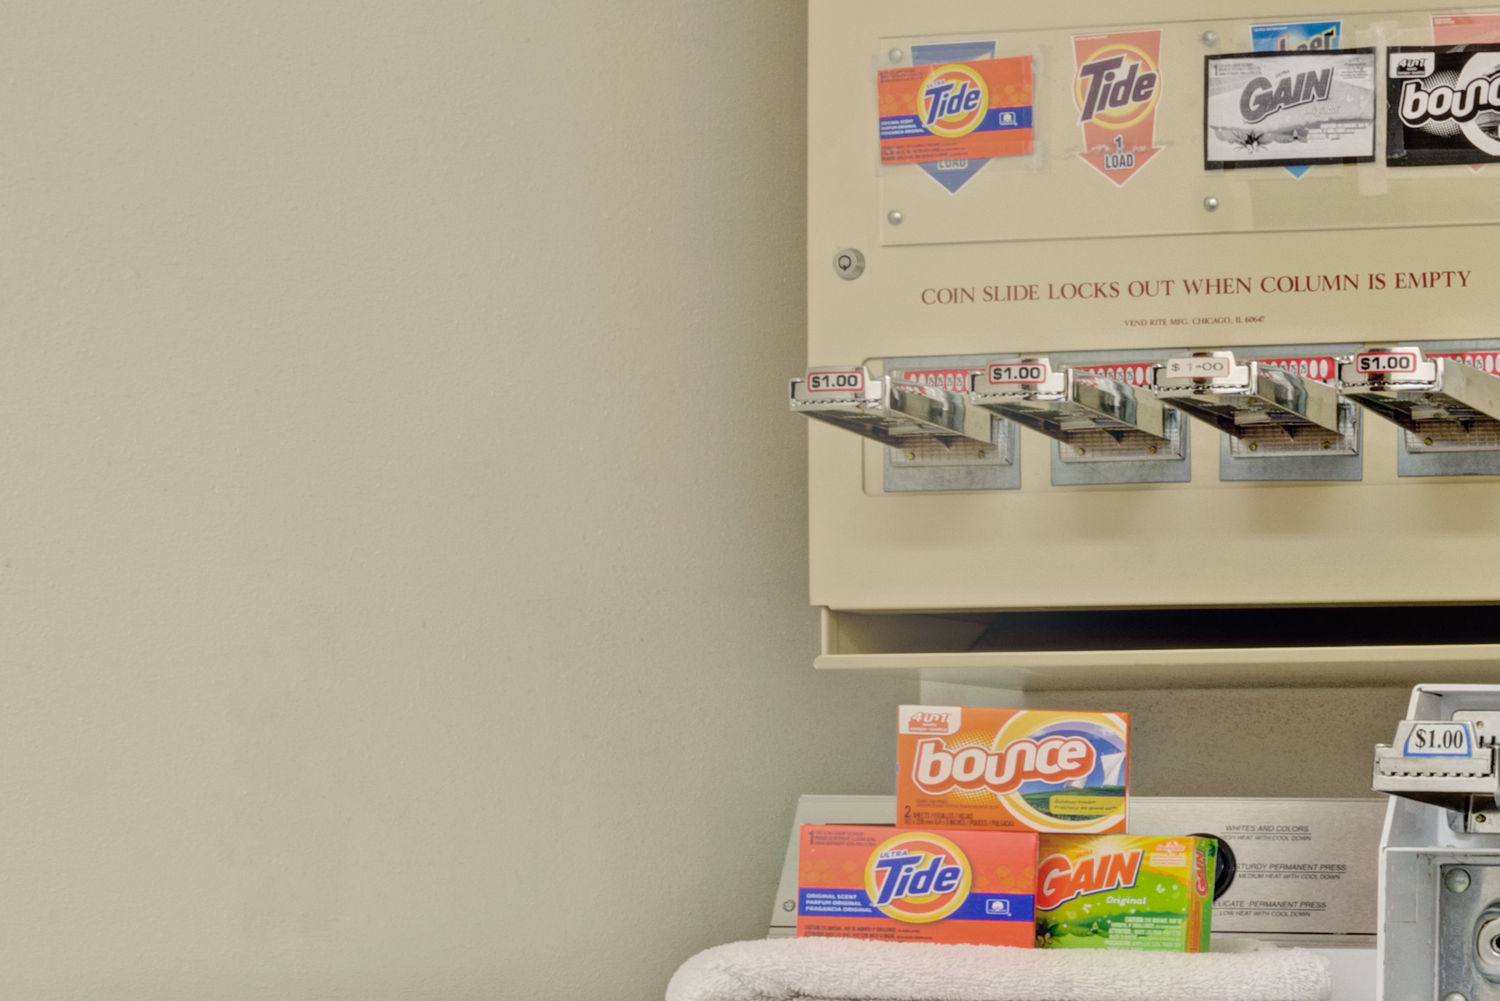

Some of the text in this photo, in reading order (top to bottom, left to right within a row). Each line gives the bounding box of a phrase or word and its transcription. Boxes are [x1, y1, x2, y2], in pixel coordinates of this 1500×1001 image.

[1080, 55, 1157, 122] Tide
[1240, 68, 1333, 122] GAIN
[924, 80, 981, 126] Tide
[1105, 154, 1134, 169] LOAD
[921, 270, 1471, 304] COIN SLIDE LOCKS OUT WHEN COLUMN IS EMPTY
[993, 366, 1040, 380] $1.00
[1360, 357, 1410, 370] $1.00
[811, 374, 858, 388] $1.00
[1415, 727, 1464, 751] $1.00
[919, 740, 1080, 784] bounce
[1276, 825, 1310, 833] COLORS
[880, 850, 908, 858] ULTRA
[1320, 864, 1347, 872] PRESS
[876, 855, 961, 904] Tide
[1037, 850, 1142, 909] GAIN
[1106, 896, 1147, 906] Original
